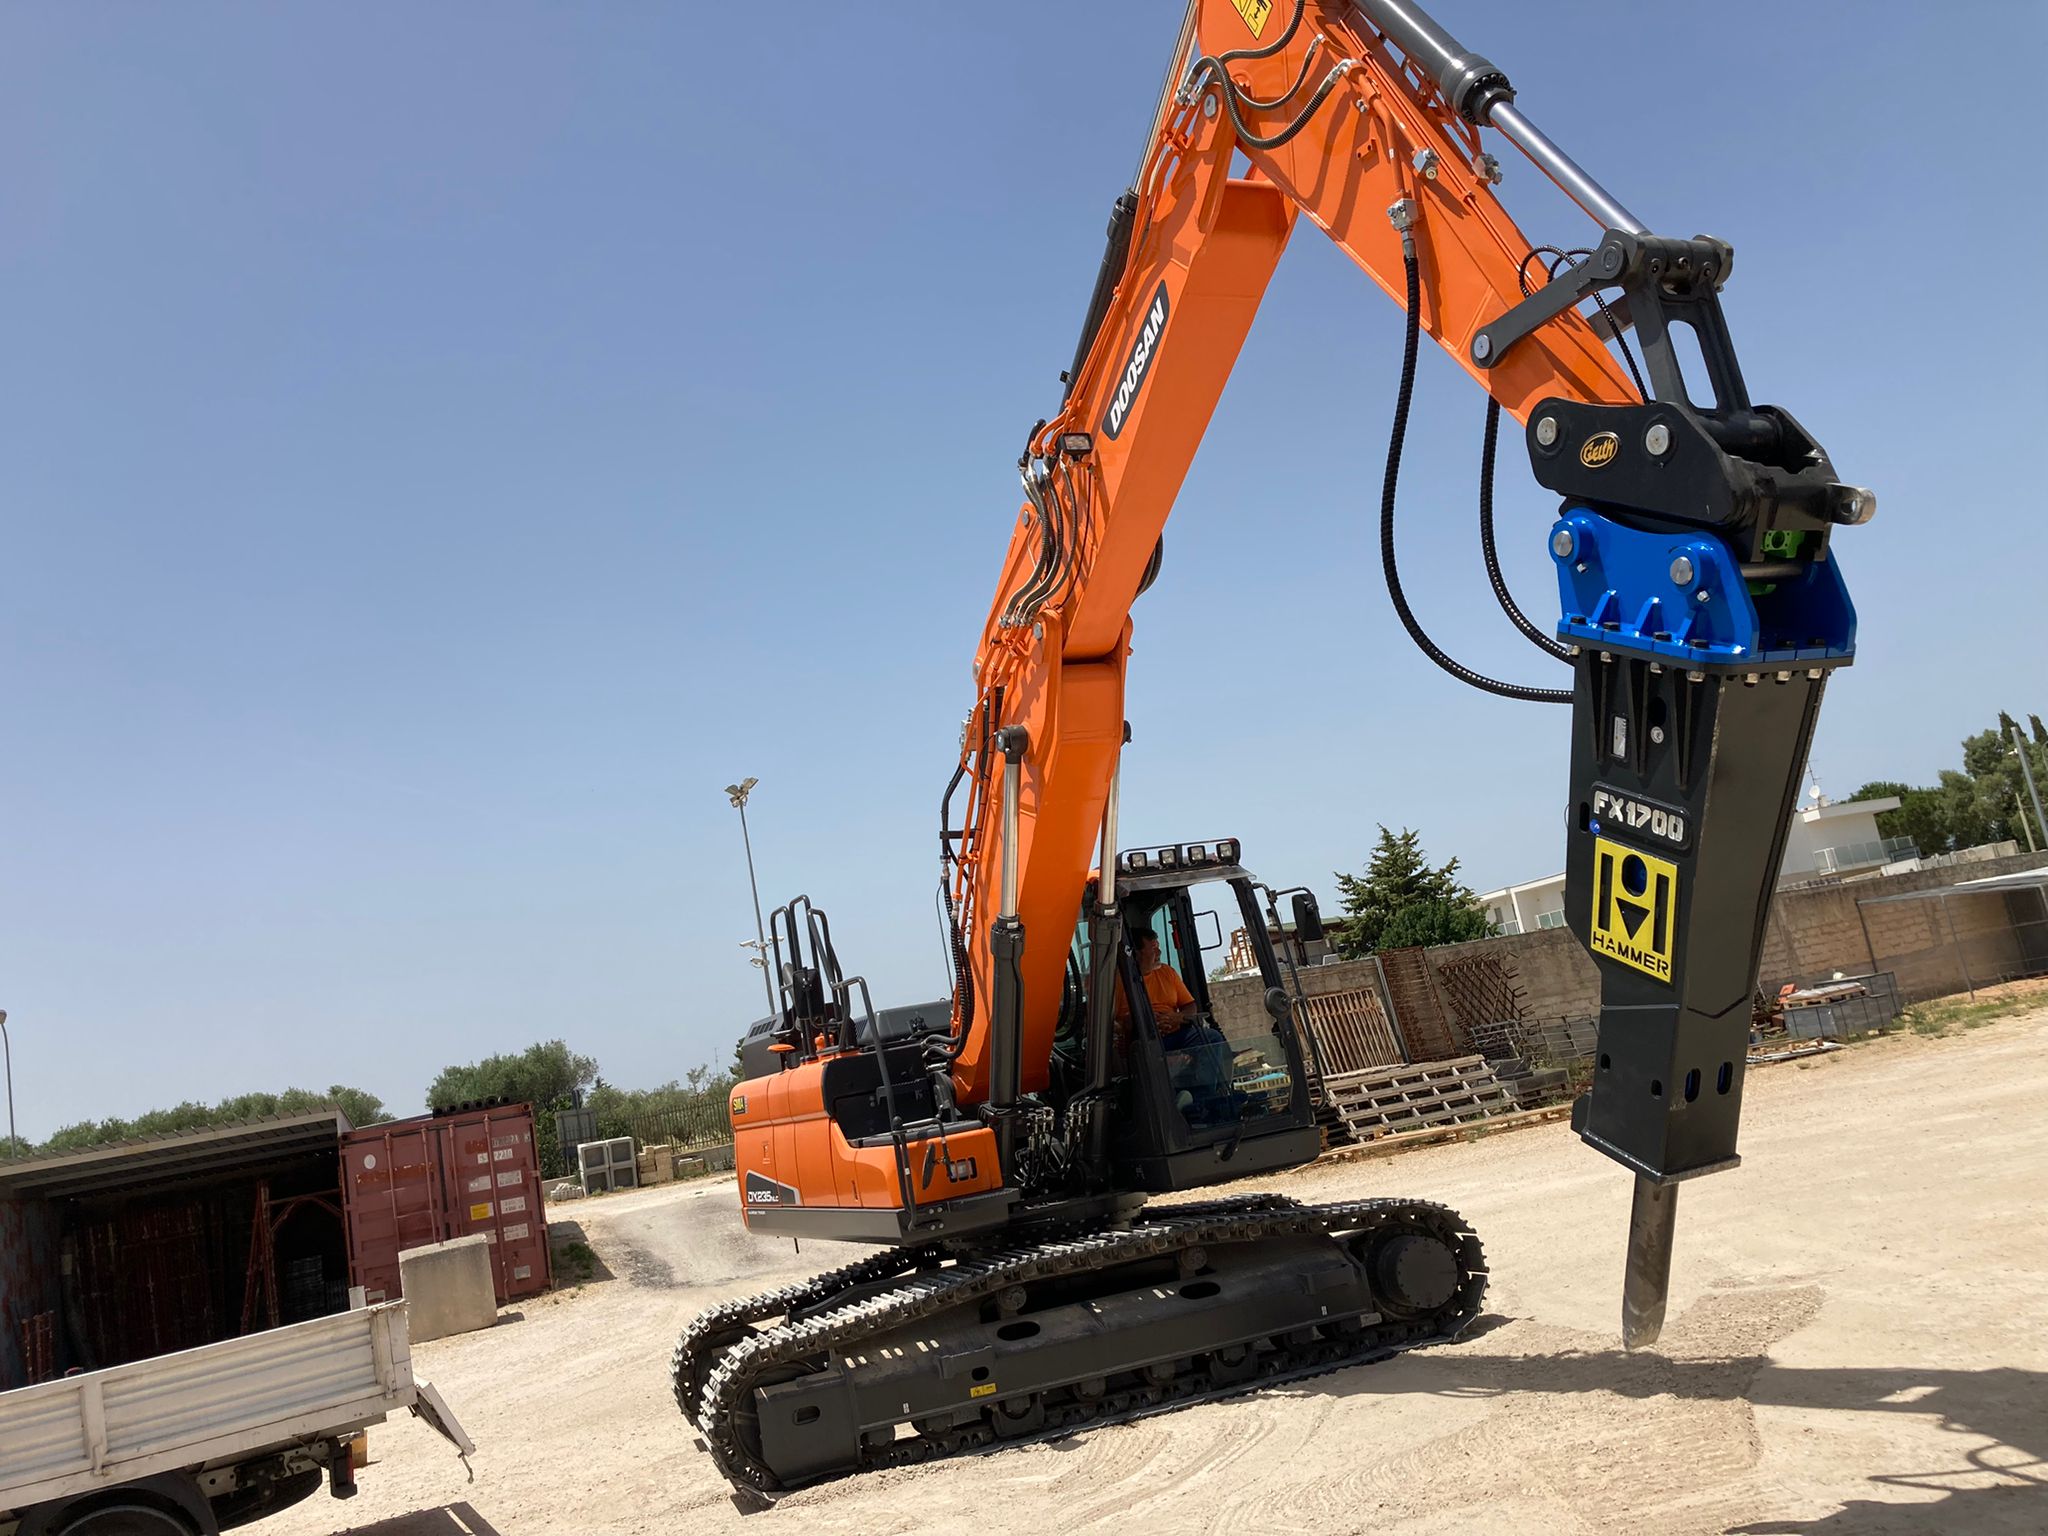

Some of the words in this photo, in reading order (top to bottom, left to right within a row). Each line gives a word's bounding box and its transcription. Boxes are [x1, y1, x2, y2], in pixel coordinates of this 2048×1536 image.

[1109, 297, 1165, 433] DOOSAN
[1593, 790, 1685, 842] FX1700
[1593, 931, 1670, 977] HAMMER
